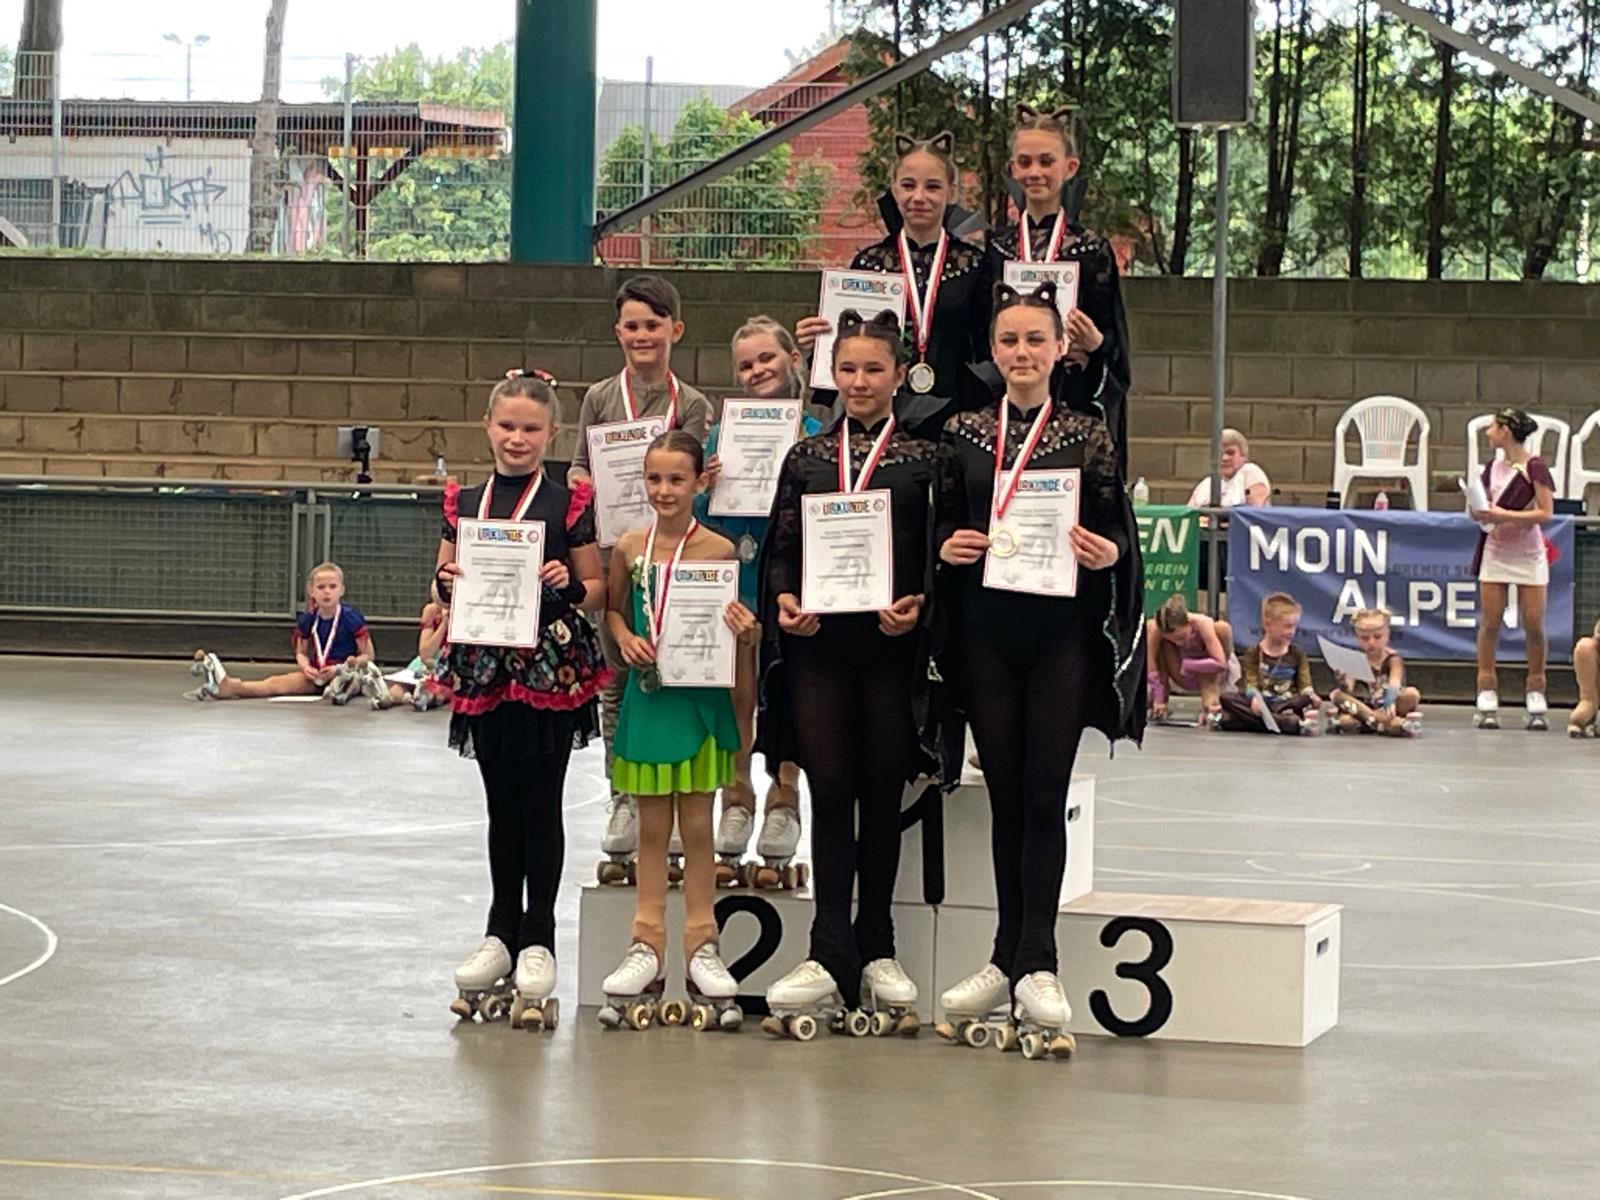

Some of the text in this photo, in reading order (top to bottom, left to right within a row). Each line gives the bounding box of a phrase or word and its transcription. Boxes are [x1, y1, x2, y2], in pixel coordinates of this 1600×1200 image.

[1135, 516, 1190, 554] EN
[1145, 562, 1189, 575] EREIN
[1249, 525, 1388, 575] MOIN
[898, 784, 945, 905] 1
[713, 895, 783, 1015] 2
[1089, 915, 1173, 1037] 3
